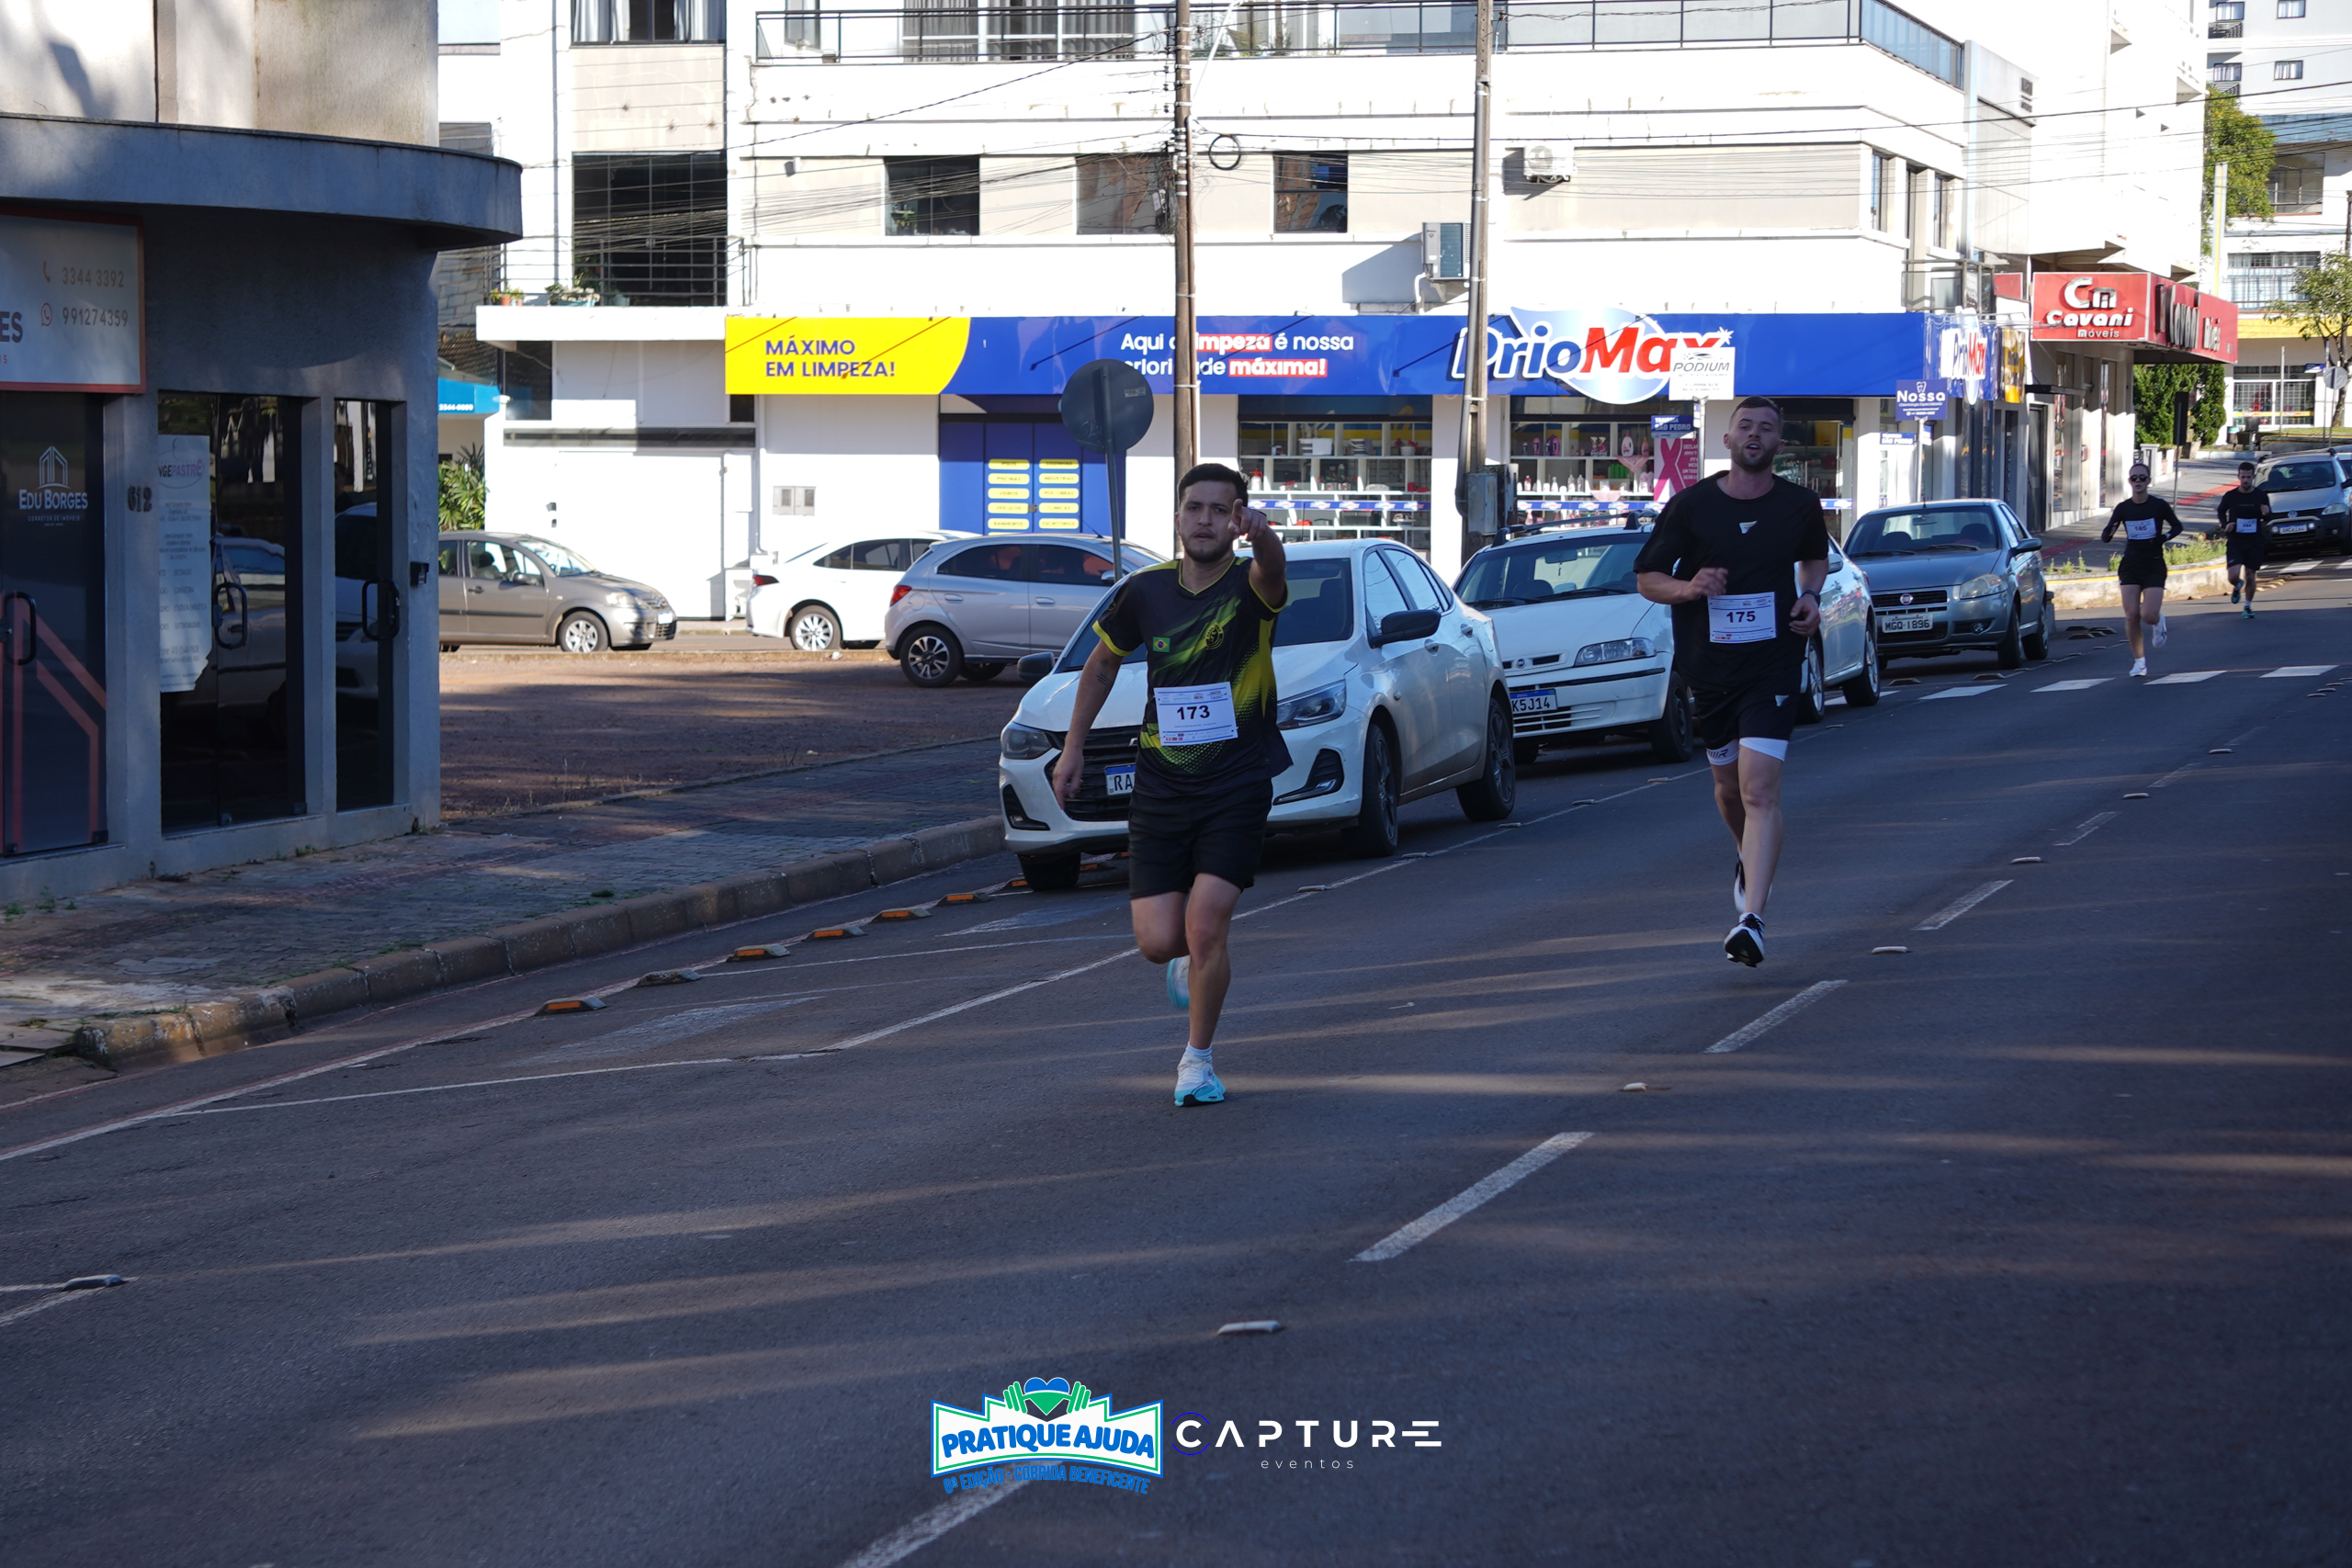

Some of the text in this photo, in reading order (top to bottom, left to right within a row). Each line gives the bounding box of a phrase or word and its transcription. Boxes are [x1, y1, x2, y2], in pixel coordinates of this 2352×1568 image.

[62, 267, 124, 288] 3344 3392
[62, 307, 128, 327] 991274359
[765, 334, 855, 355] MÁXIMO
[1121, 333, 1164, 355] Aqui
[1194, 332, 1271, 355] impeza
[1274, 333, 1287, 350] é
[1294, 335, 1353, 350] nossa
[765, 361, 895, 378] EM LIMPEZA!
[1229, 358, 1326, 376] máxima!
[1673, 363, 1730, 372] PODIUM
[1896, 389, 1946, 403] Nossa
[43, 490, 88, 510] BORGES
[1726, 610, 1756, 624] 175
[1884, 619, 1930, 631] MGQ-1896
[1176, 705, 1211, 721] 173
